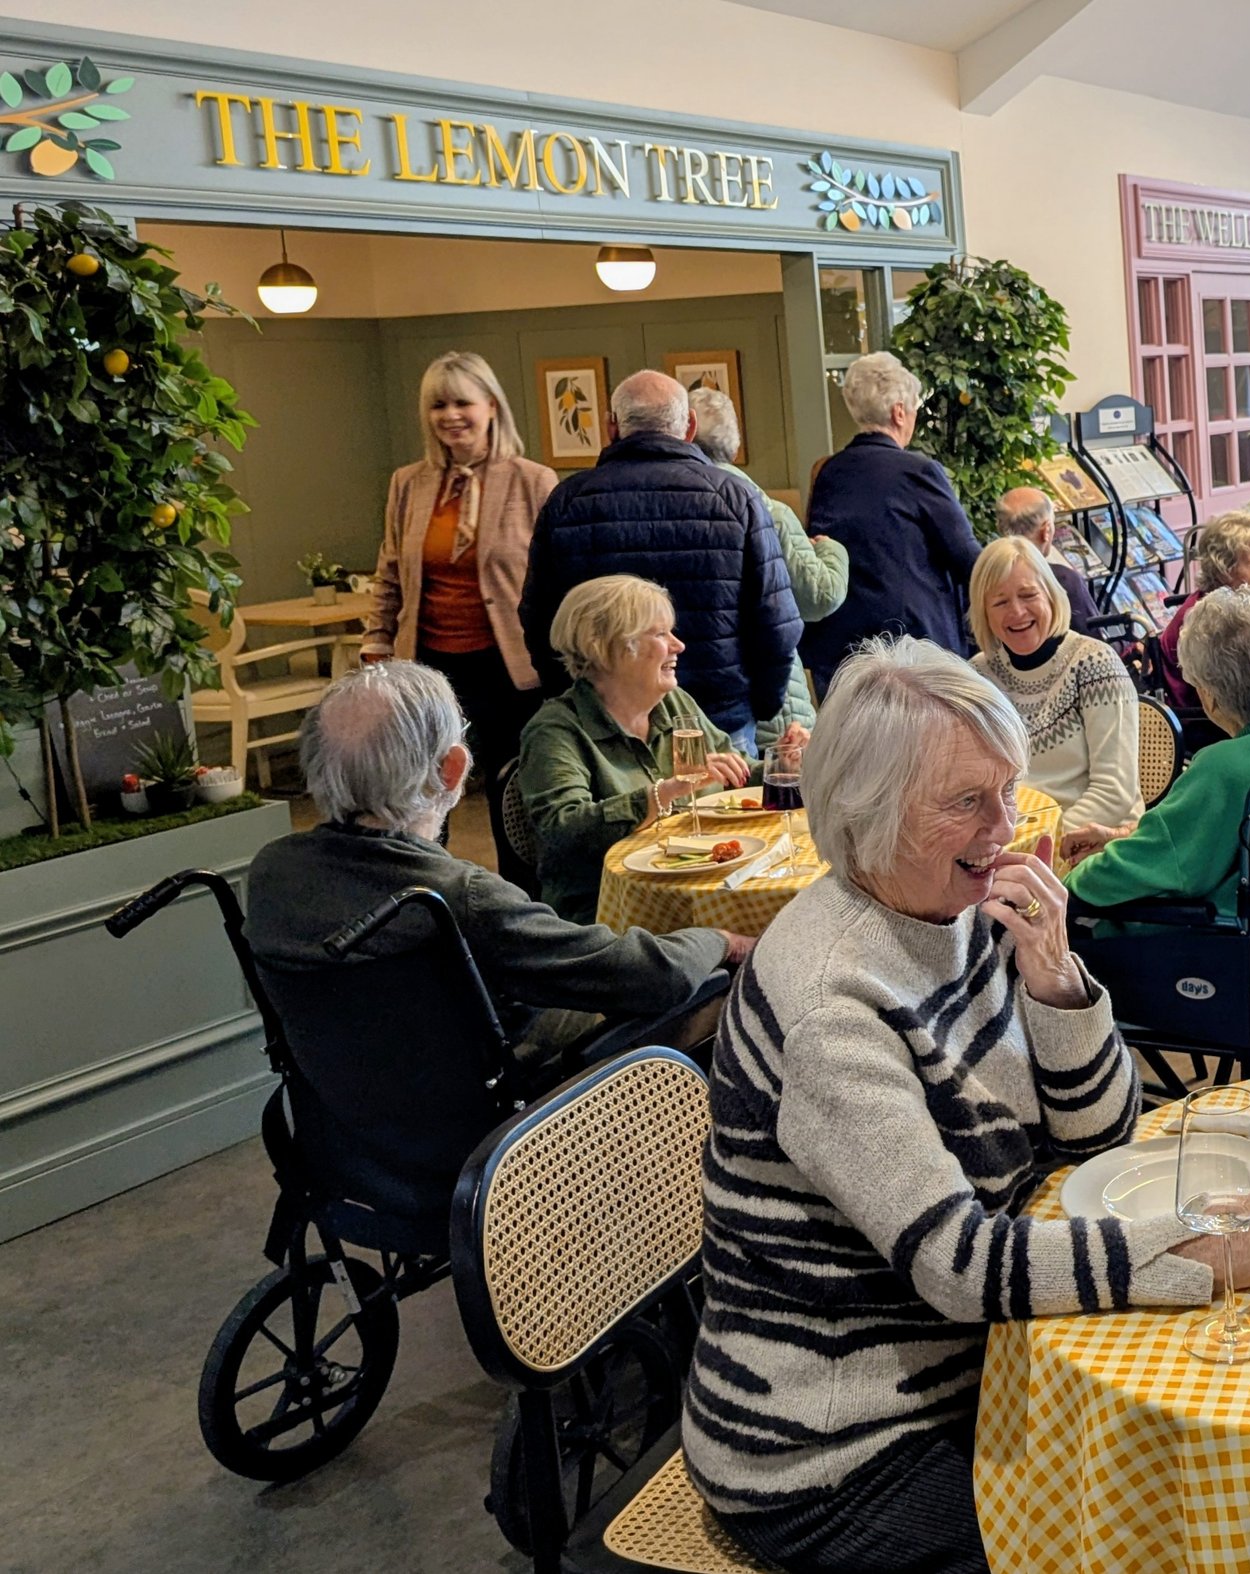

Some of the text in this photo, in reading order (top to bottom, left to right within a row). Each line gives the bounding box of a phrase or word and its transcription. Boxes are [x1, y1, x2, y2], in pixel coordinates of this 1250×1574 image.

[195, 89, 779, 210] THE LEMON TREE
[1143, 202, 1193, 245] THE
[1181, 980, 1209, 996] days
